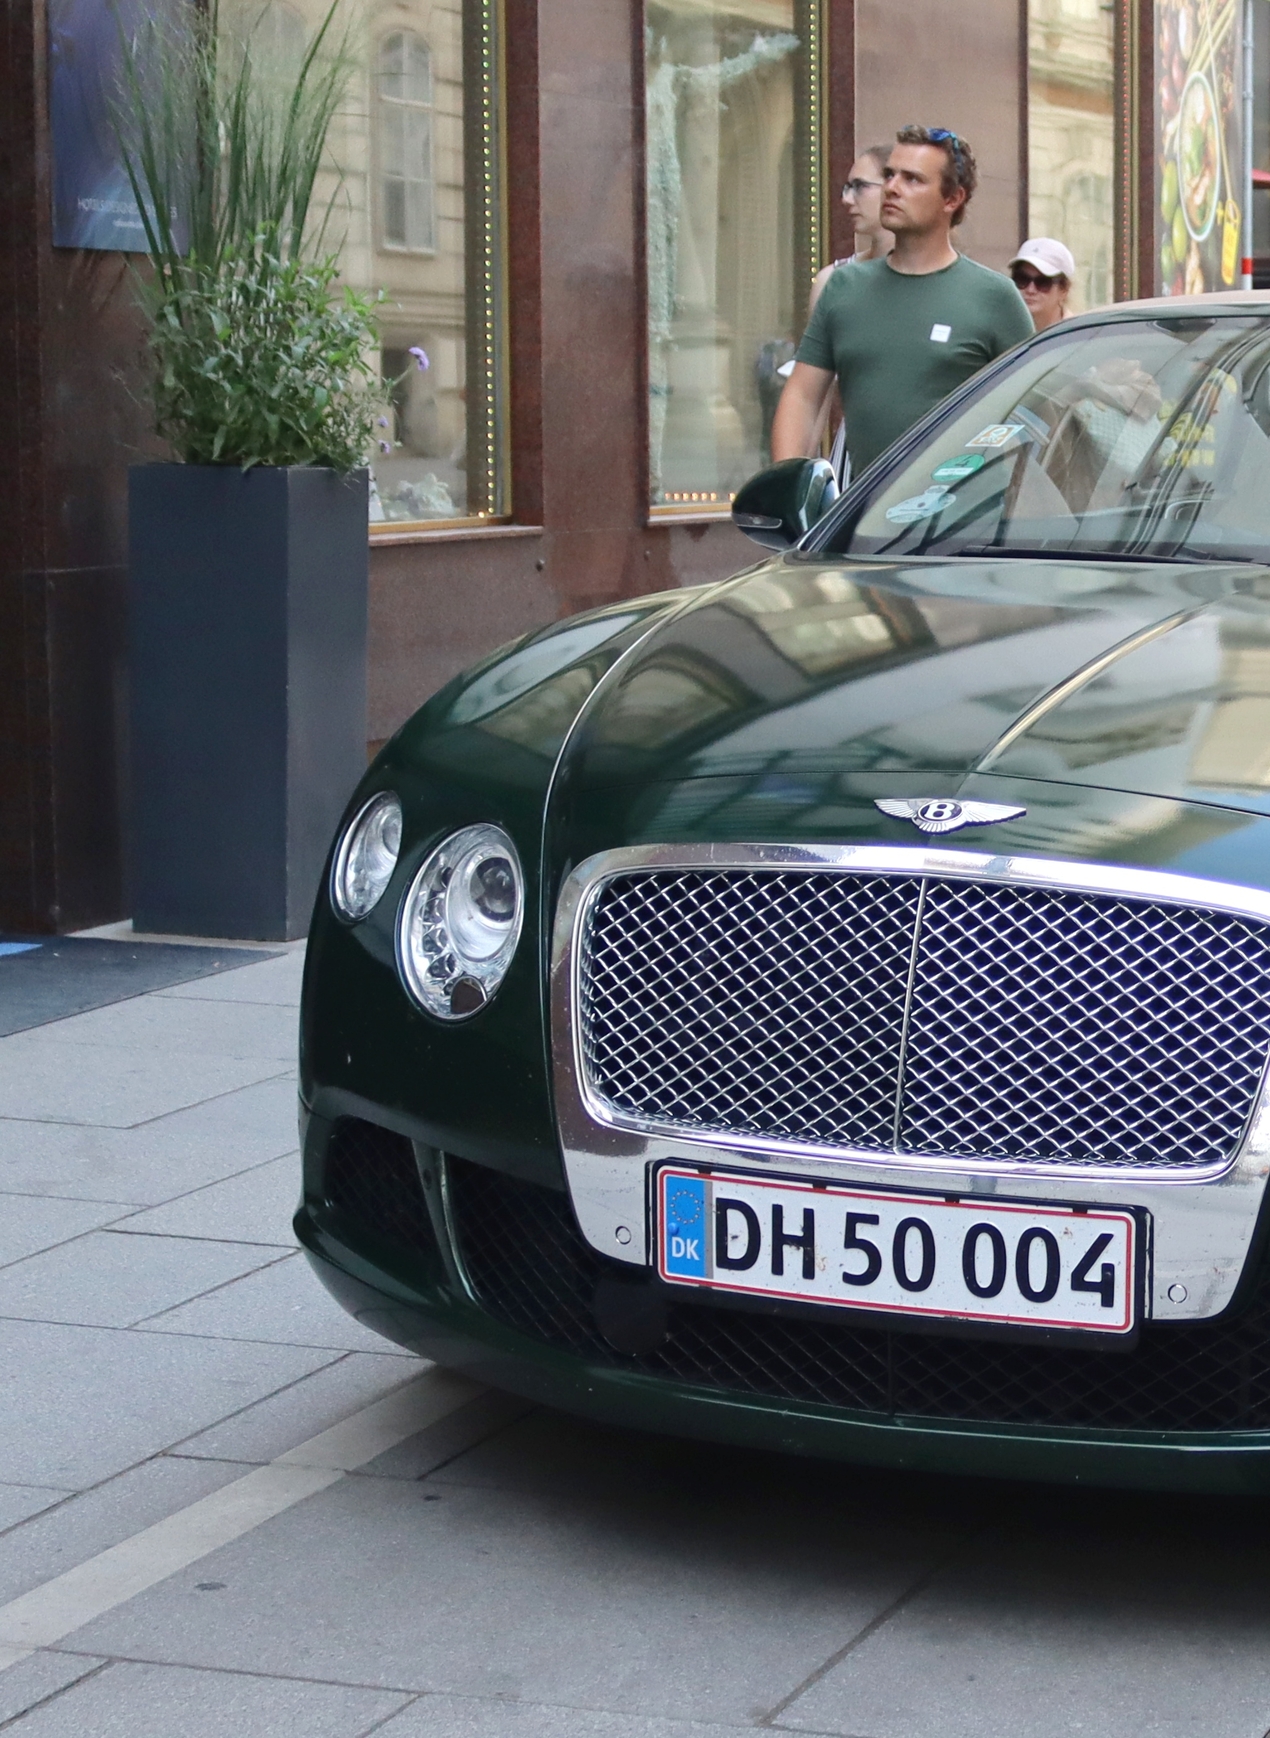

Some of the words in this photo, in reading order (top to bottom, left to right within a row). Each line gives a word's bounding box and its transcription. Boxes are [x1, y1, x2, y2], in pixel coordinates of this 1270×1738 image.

[924, 802, 955, 820] B
[671, 1236, 699, 1261] DK
[716, 1198, 815, 1280] DH
[843, 1211, 935, 1293] 50
[963, 1222, 1115, 1308] 004
